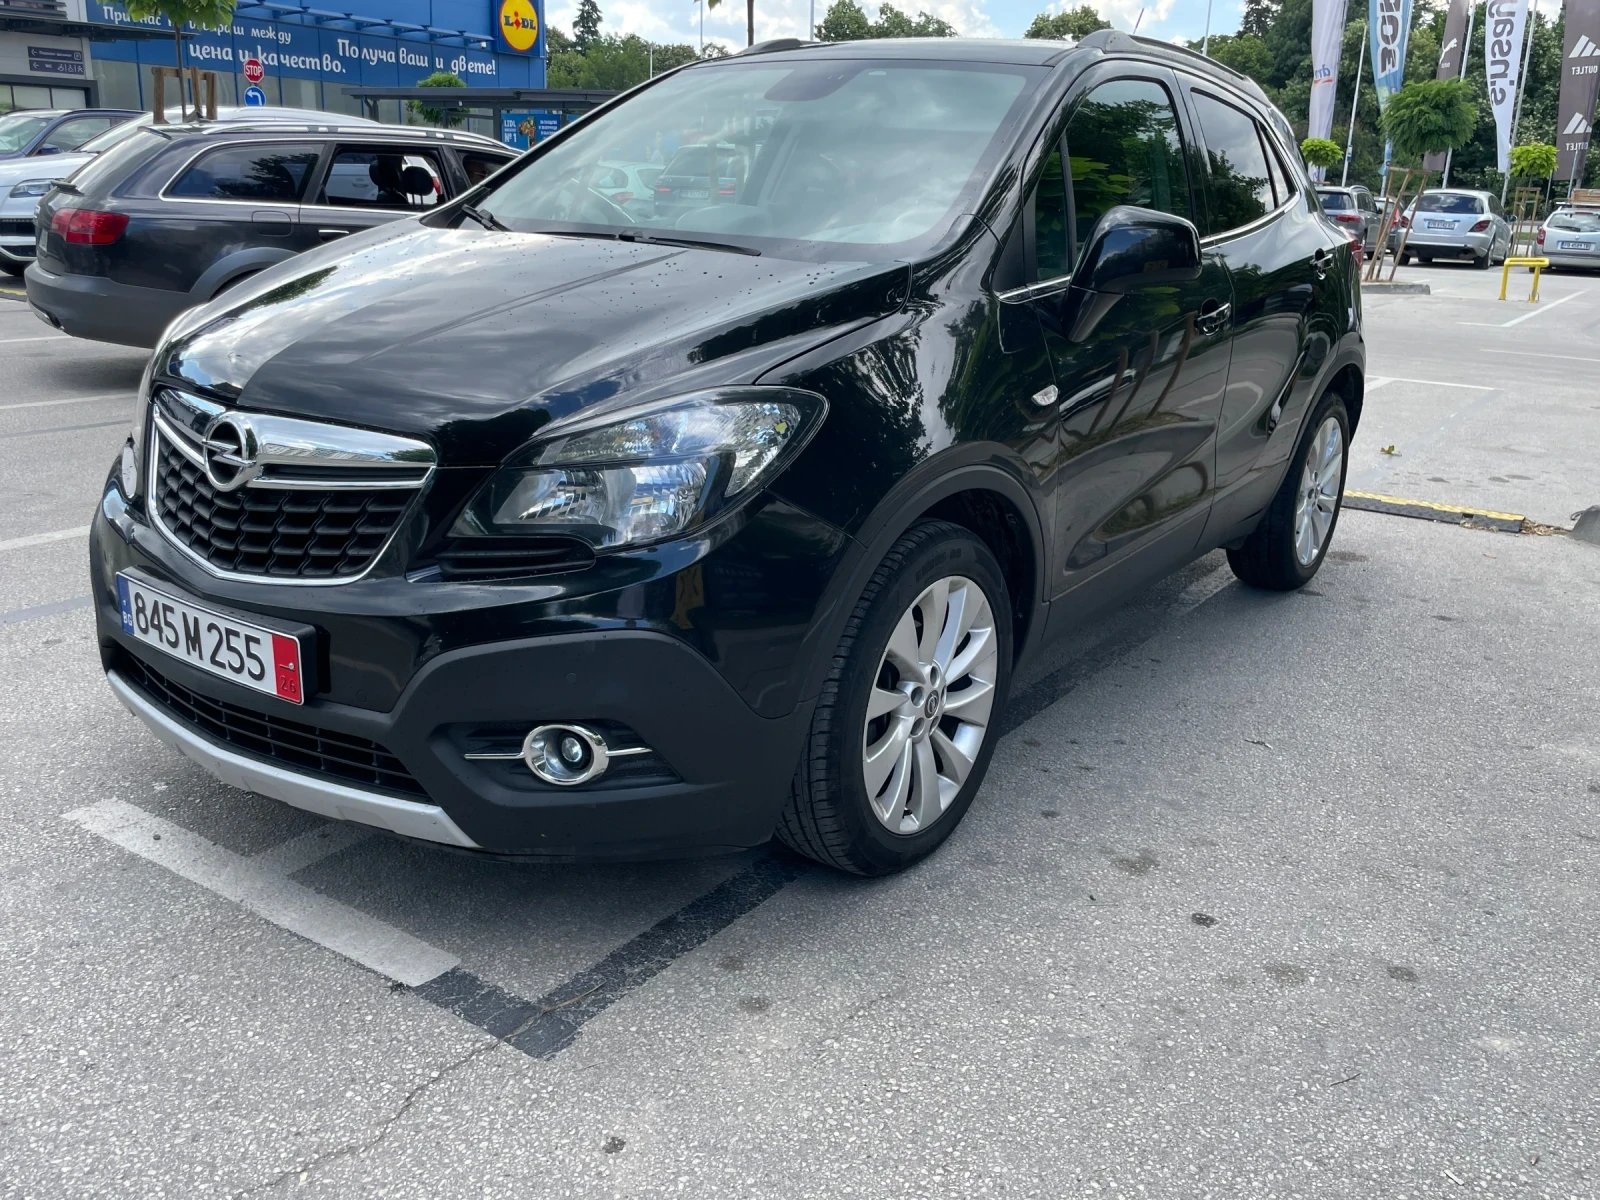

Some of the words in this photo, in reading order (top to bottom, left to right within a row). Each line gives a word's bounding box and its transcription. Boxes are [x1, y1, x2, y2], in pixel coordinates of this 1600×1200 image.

[103, 5, 131, 25] При
[251, 26, 292, 44] между
[189, 43, 233, 61] цена
[238, 49, 249, 62] и
[257, 46, 346, 73] качество.
[337, 38, 429, 67] Получаваш
[435, 57, 444, 69] и
[450, 55, 496, 75] двете!
[245, 64, 262, 76] STOP
[504, 119, 517, 128] LIDL
[122, 613, 133, 626] BG
[134, 591, 180, 649] 845
[182, 611, 204, 661] M
[207, 622, 265, 681] 255
[280, 676, 296, 694] 26
